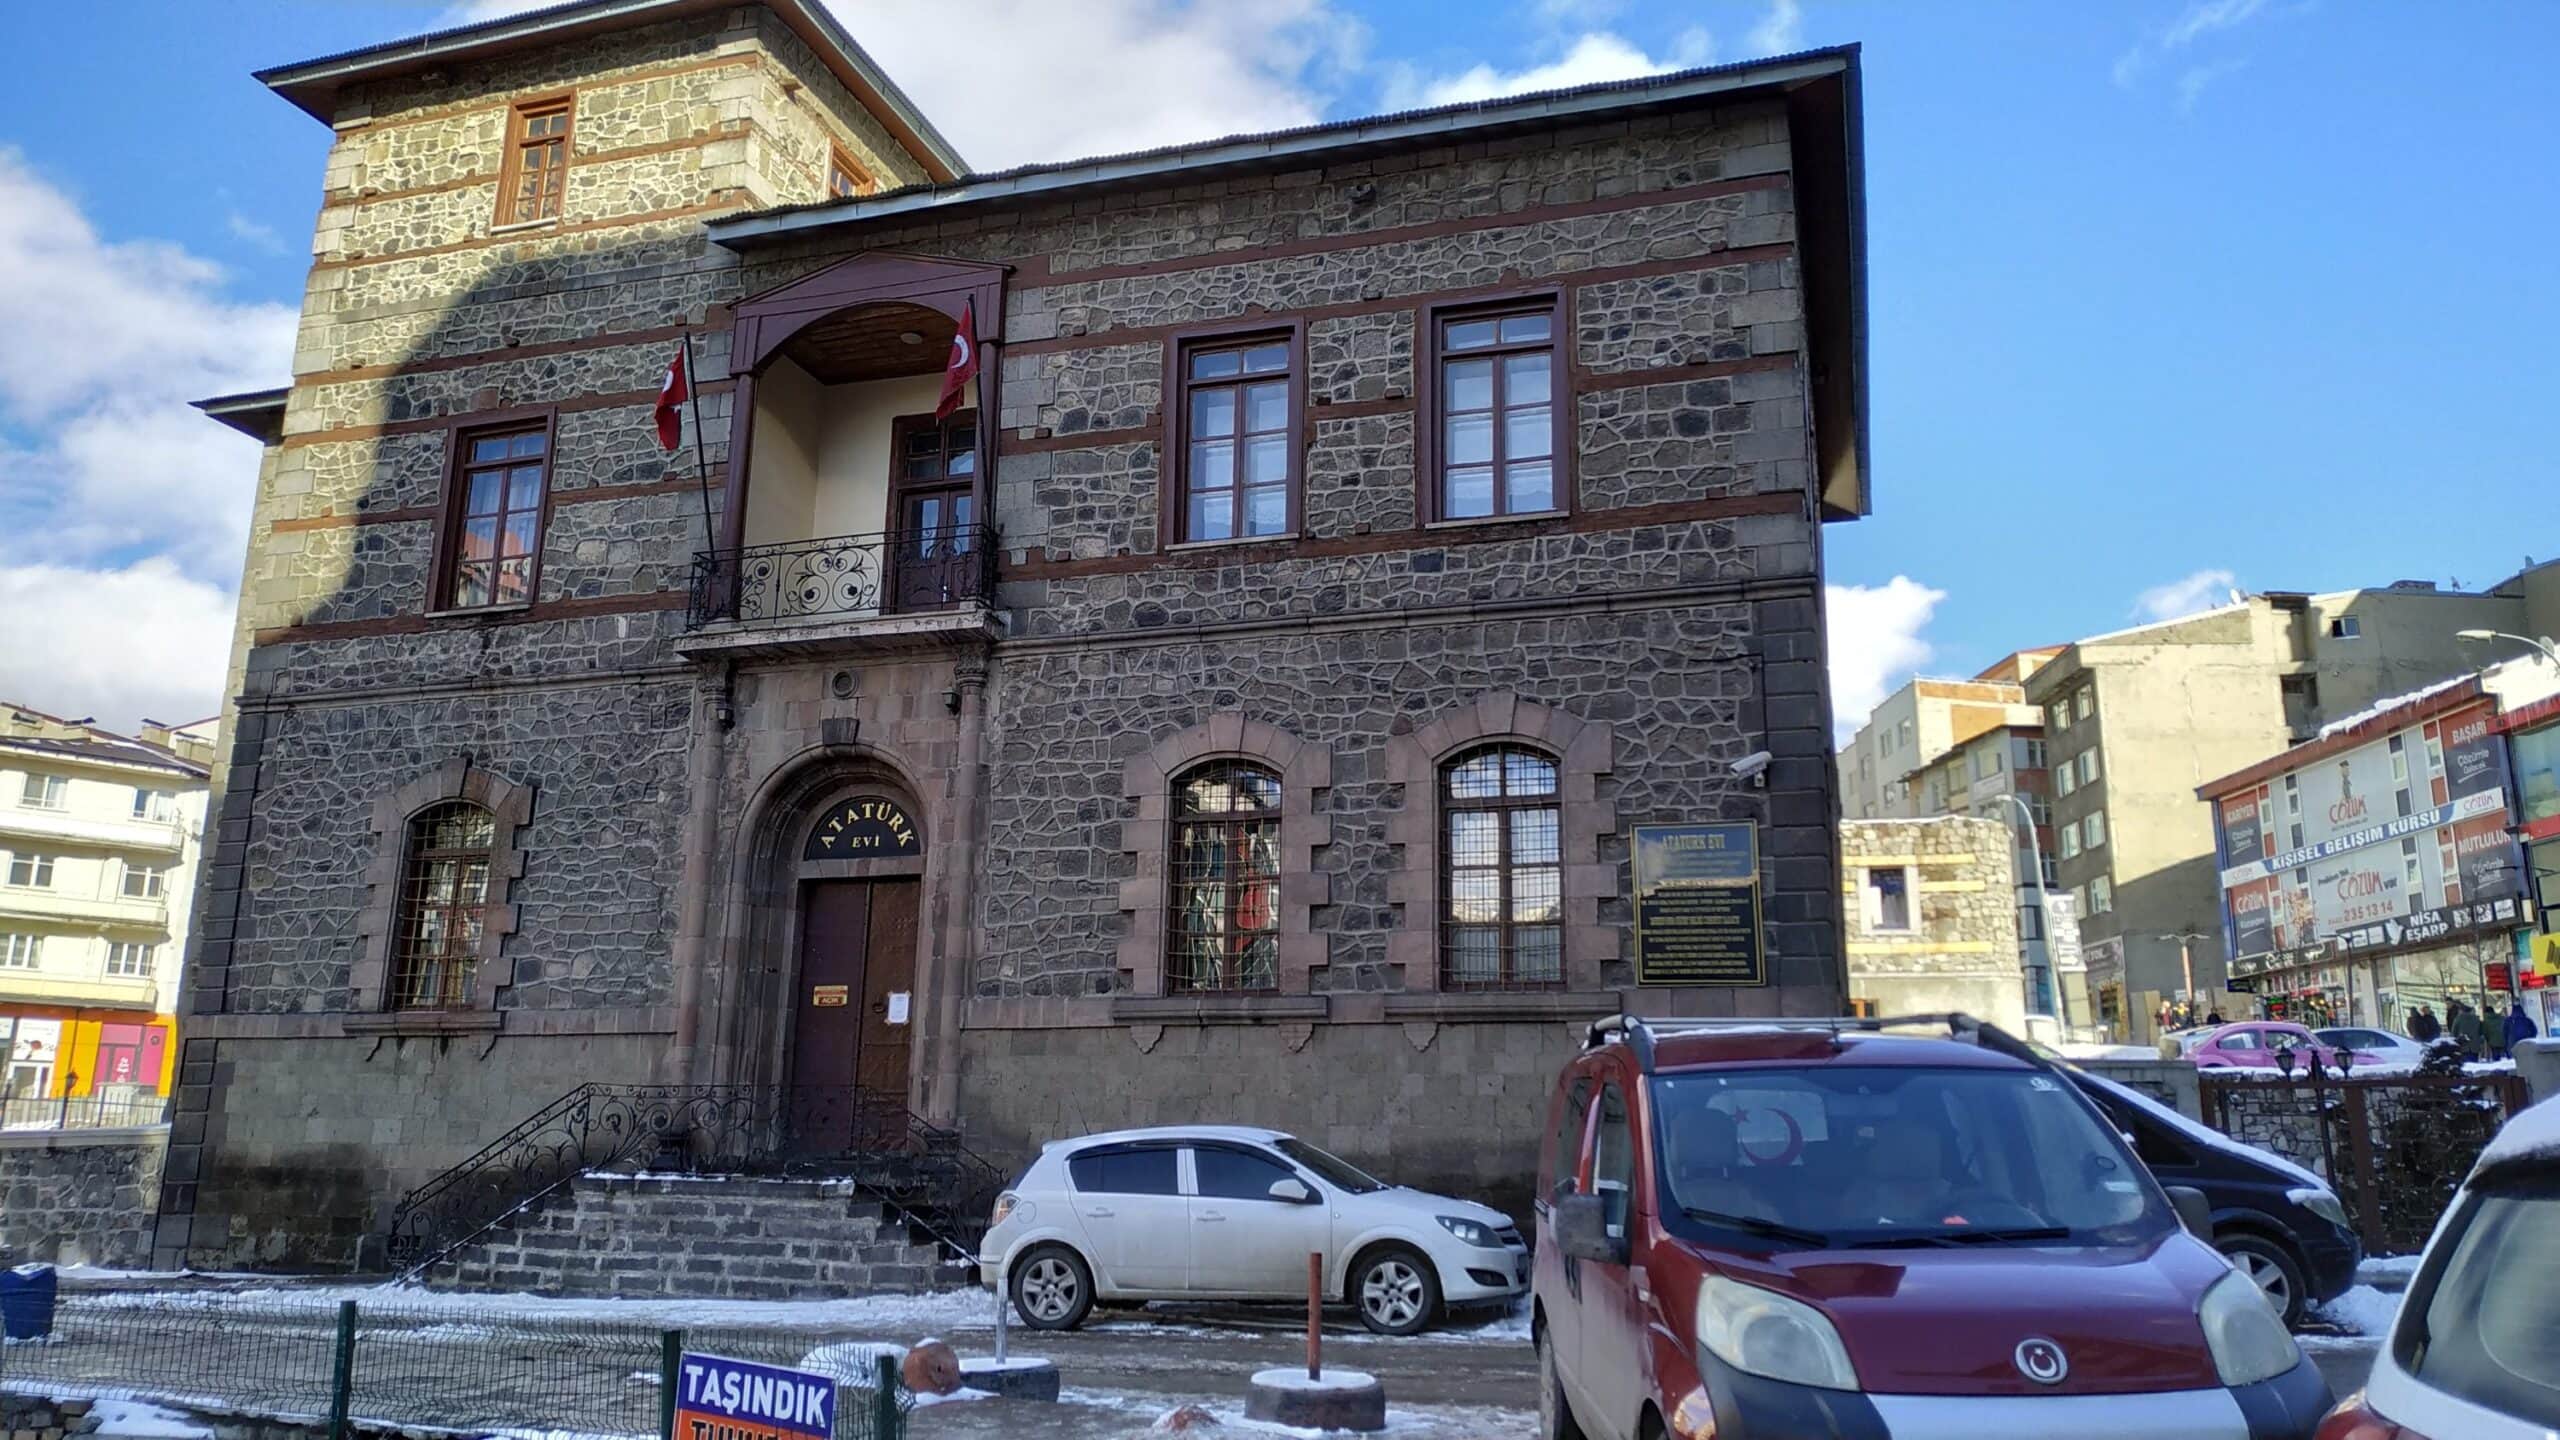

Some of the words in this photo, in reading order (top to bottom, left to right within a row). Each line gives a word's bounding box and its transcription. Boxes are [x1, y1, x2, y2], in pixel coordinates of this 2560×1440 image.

[820, 802, 914, 848] ATATÜRK
[2325, 829, 2384, 855] GELİŞİM
[2388, 809, 2441, 833] KURSU
[852, 835, 880, 848] EVİ
[2381, 900, 2393, 914] 14
[2409, 911, 2442, 926] NİSA
[2406, 922, 2449, 943] EŞARP
[684, 1364, 829, 1429] TAŞINDIK
